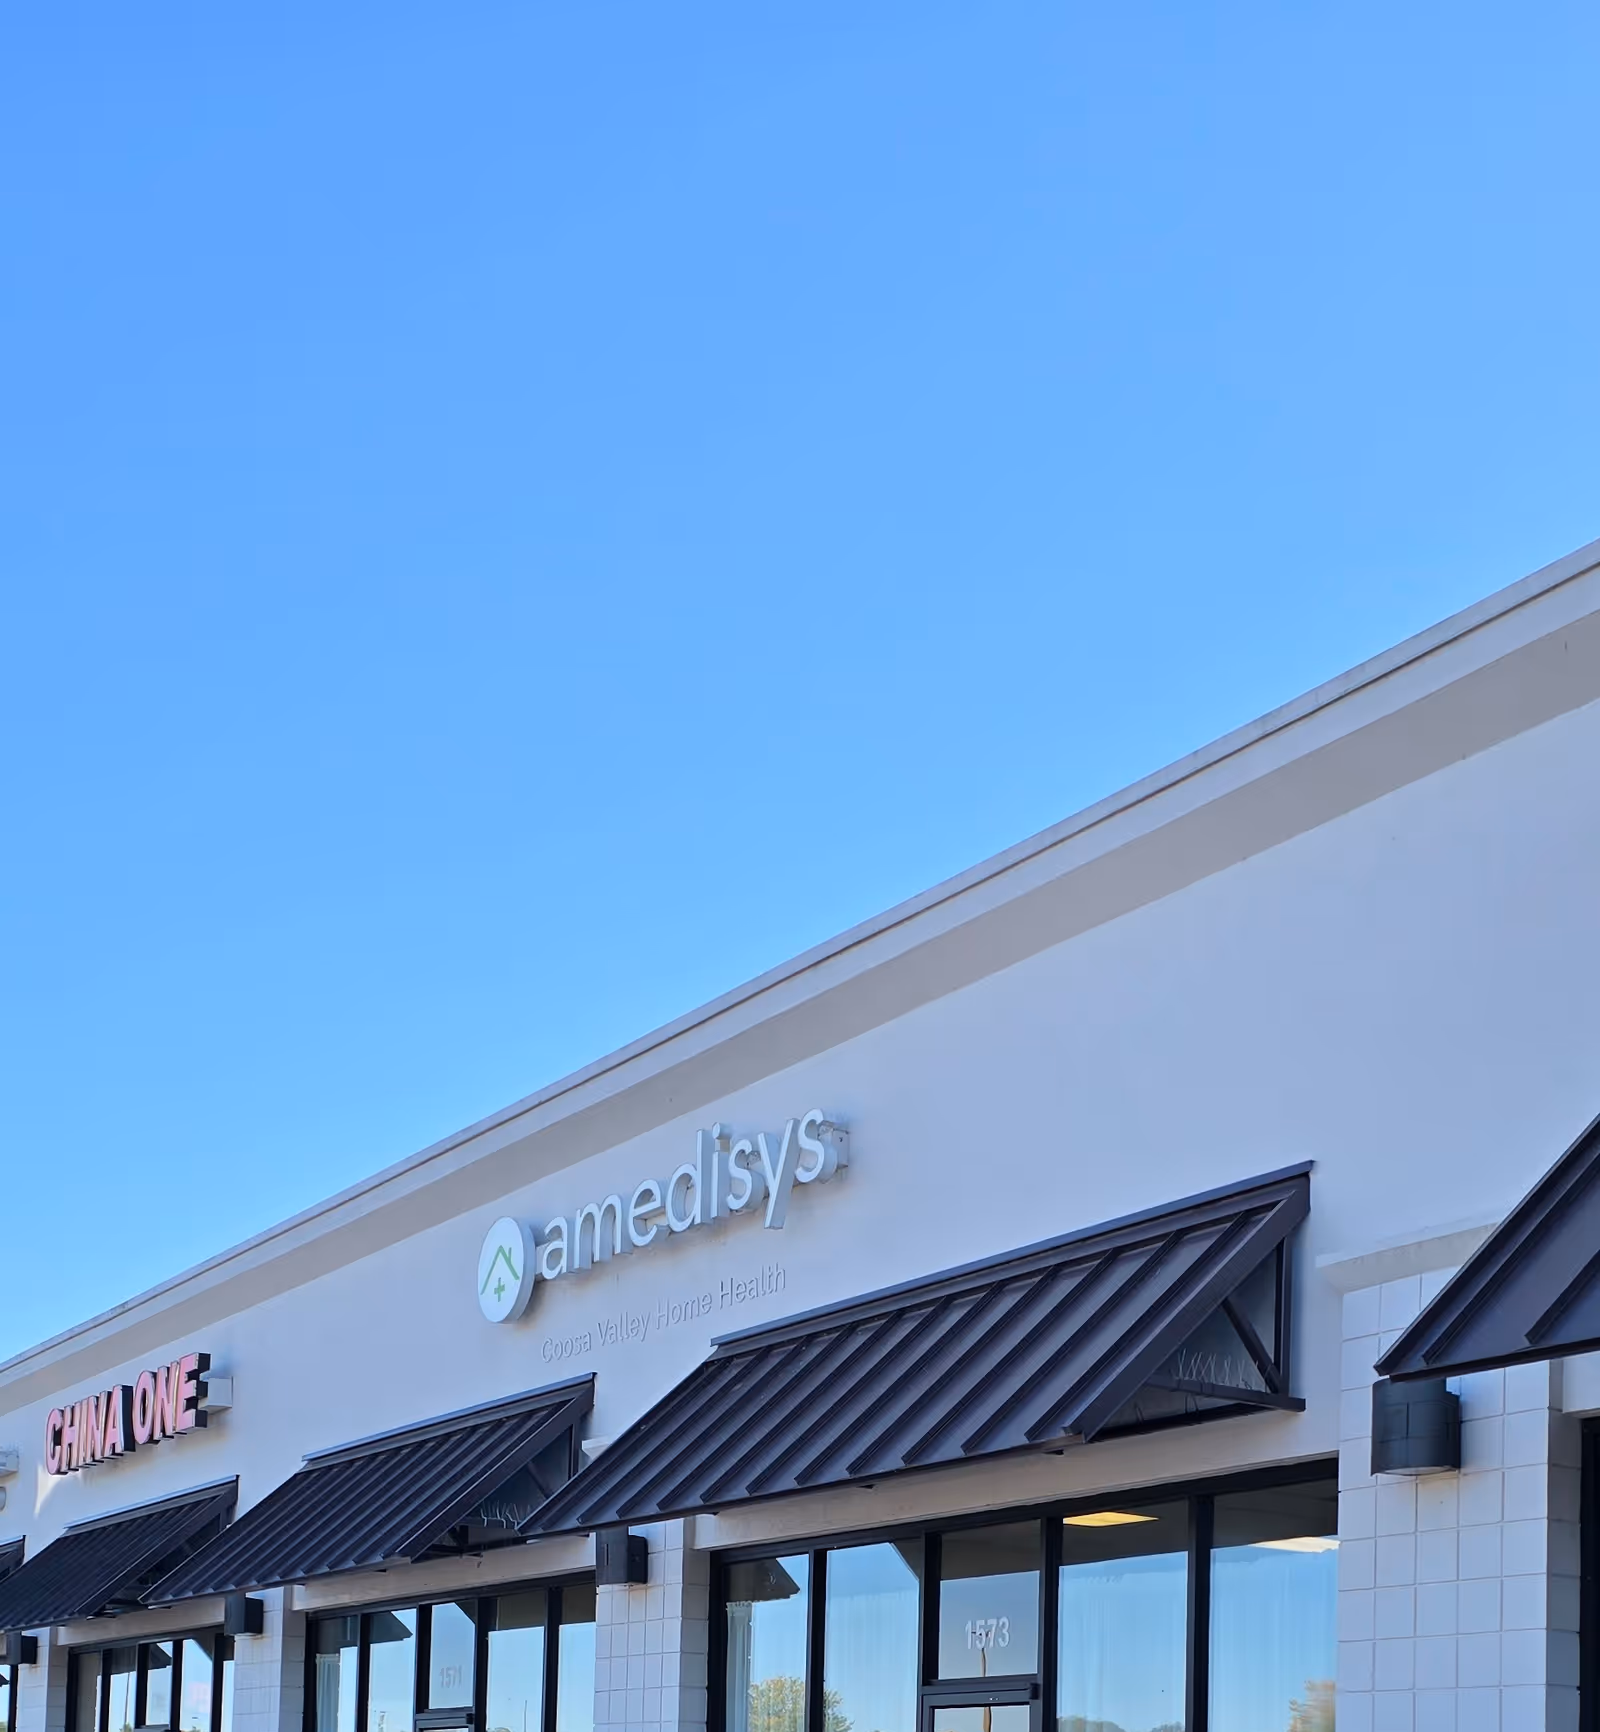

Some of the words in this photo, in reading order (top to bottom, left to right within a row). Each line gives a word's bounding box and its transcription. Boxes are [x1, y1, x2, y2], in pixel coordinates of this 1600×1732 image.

[541, 1108, 825, 1280] amedisys
[541, 1331, 592, 1363] Coosa
[597, 1311, 650, 1346] Valley
[655, 1292, 712, 1330] Home
[720, 1263, 786, 1310] Health
[46, 1384, 125, 1475] CHINA
[133, 1352, 200, 1445] ONE
[440, 1664, 463, 1689] 1571
[965, 1616, 1010, 1650] 1573
